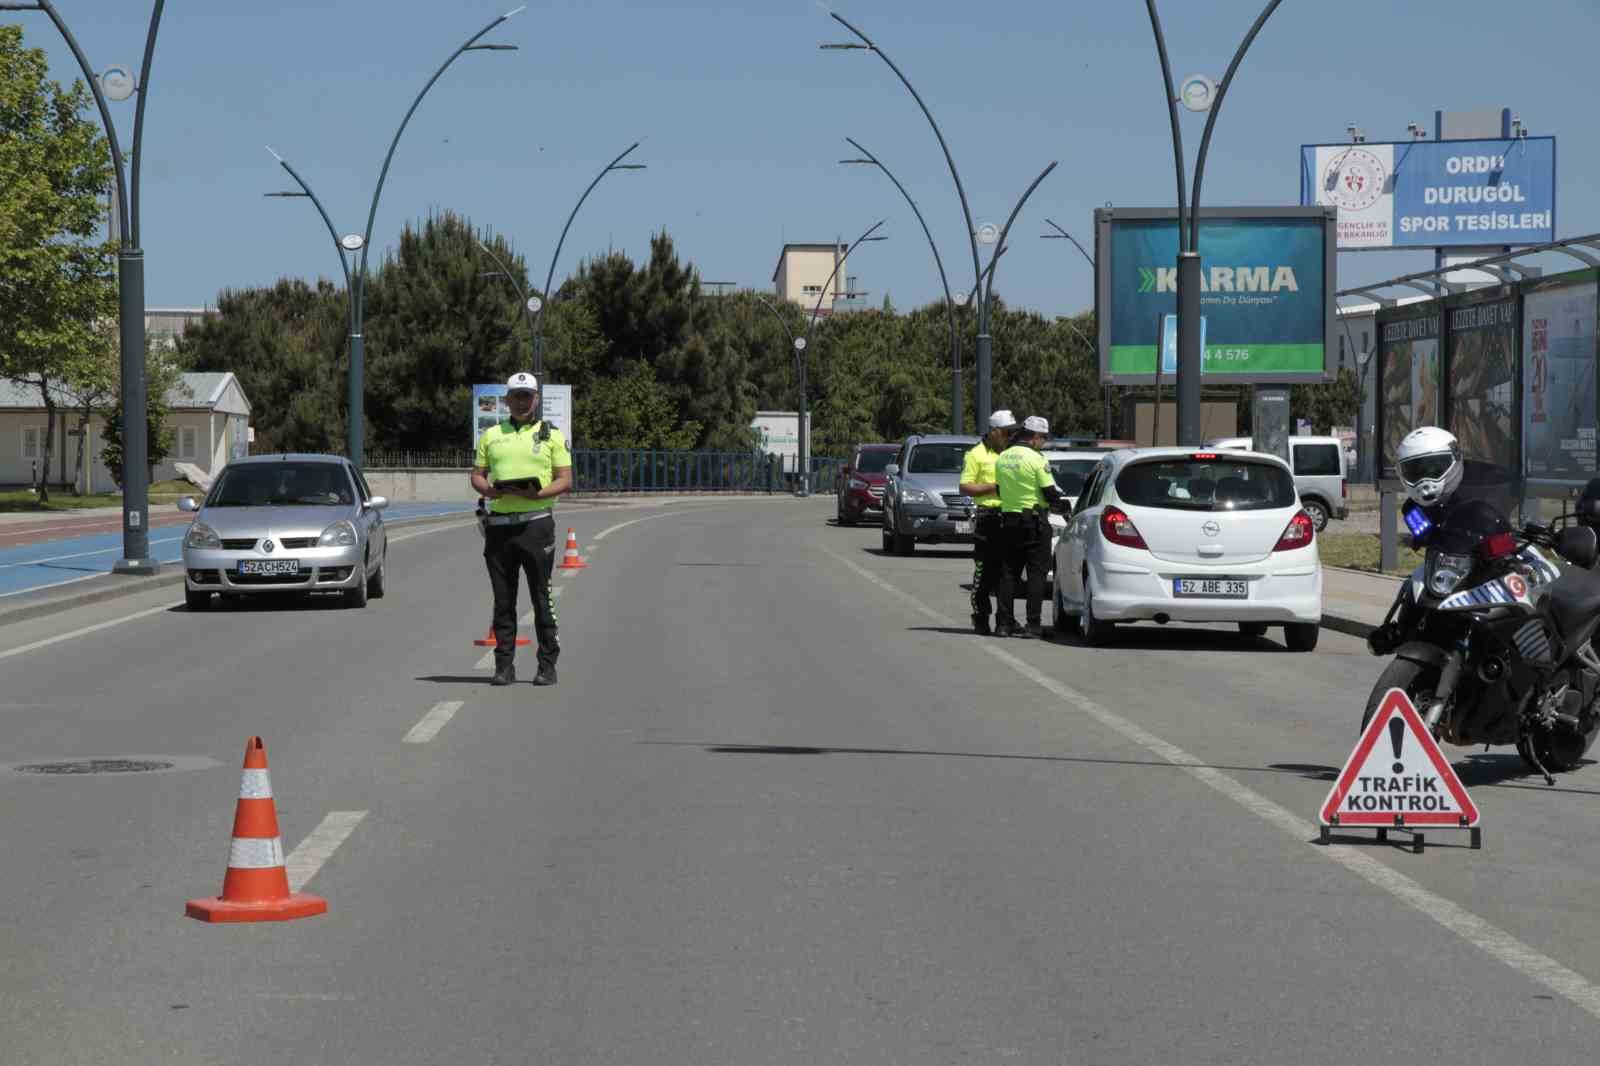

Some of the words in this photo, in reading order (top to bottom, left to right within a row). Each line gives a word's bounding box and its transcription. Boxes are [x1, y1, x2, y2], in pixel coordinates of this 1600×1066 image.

[1424, 182, 1526, 204] DURUGÖL
[1399, 216, 1449, 232] SPOR
[1455, 209, 1551, 231] TESİSLERİ
[1226, 349, 1249, 360] 576
[1182, 580, 1195, 593] 52
[1201, 580, 1221, 593] ABE
[1226, 581, 1245, 593] 335
[1359, 773, 1437, 792] TRAFİK
[1347, 795, 1450, 810] KONTROL
